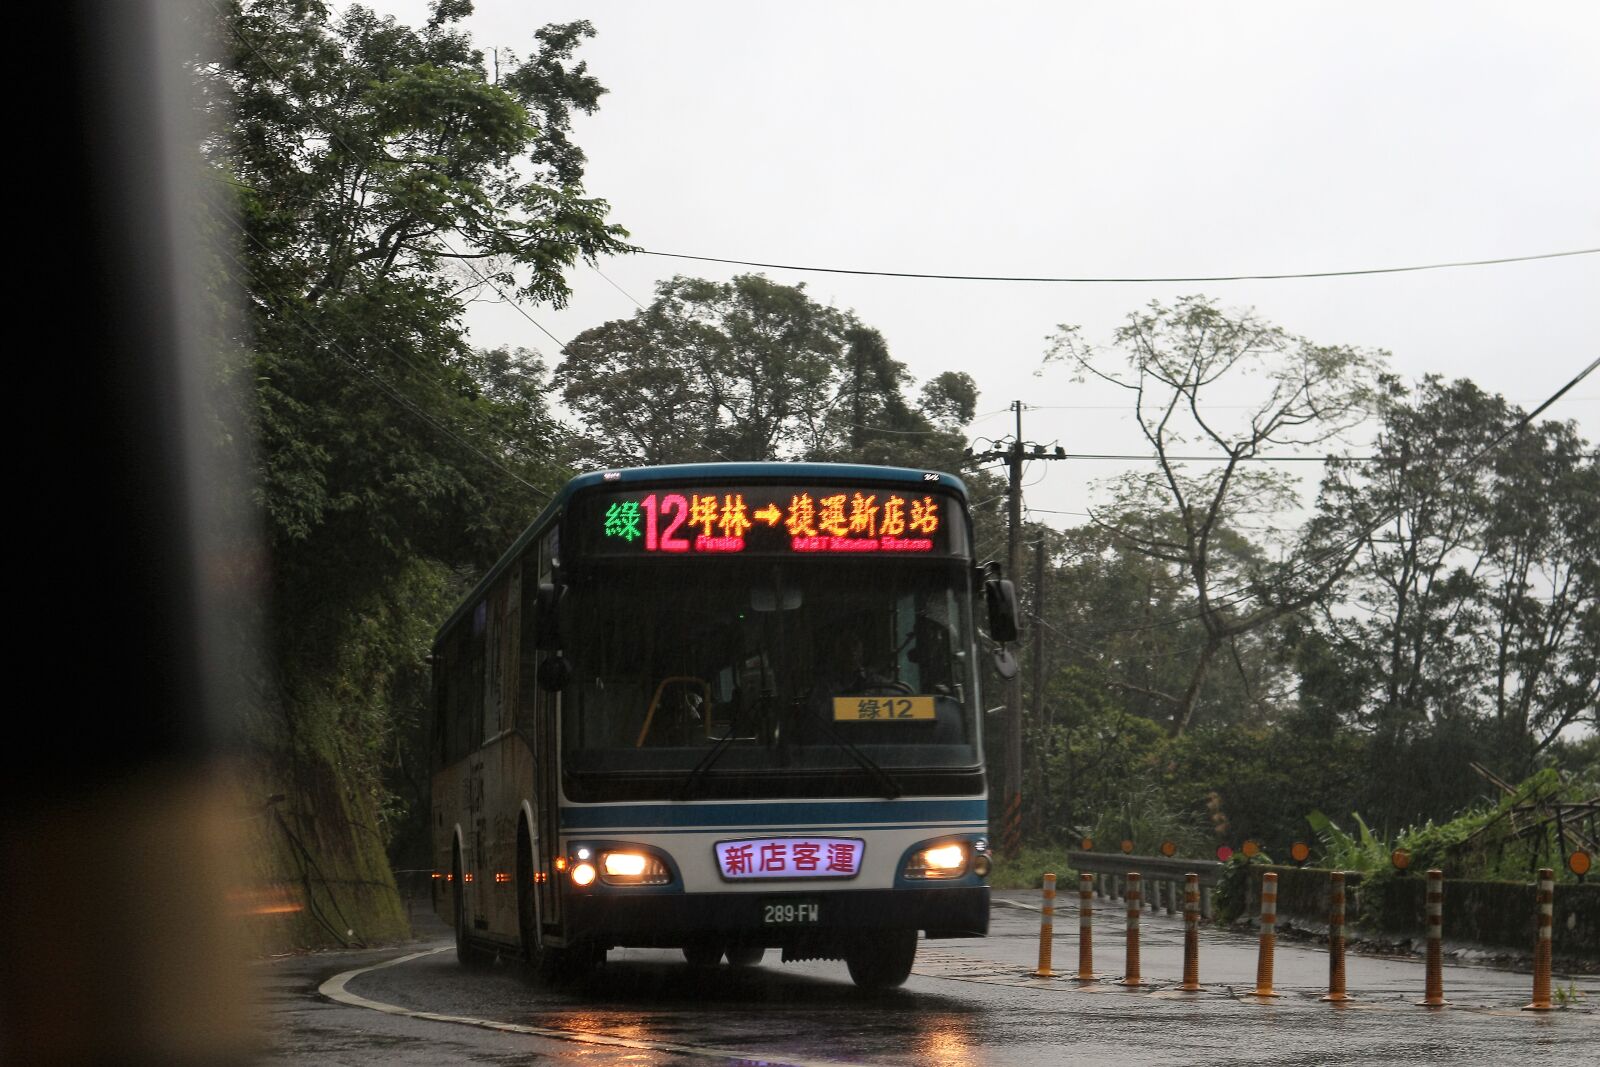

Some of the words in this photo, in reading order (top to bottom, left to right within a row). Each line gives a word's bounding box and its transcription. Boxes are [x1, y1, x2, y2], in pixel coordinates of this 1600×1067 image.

[688, 494, 752, 537] 坪林
[784, 492, 939, 537] 捷運新店站
[858, 699, 913, 719] 綠12
[724, 842, 856, 875] 新店客運
[764, 904, 818, 922] 289-FW
